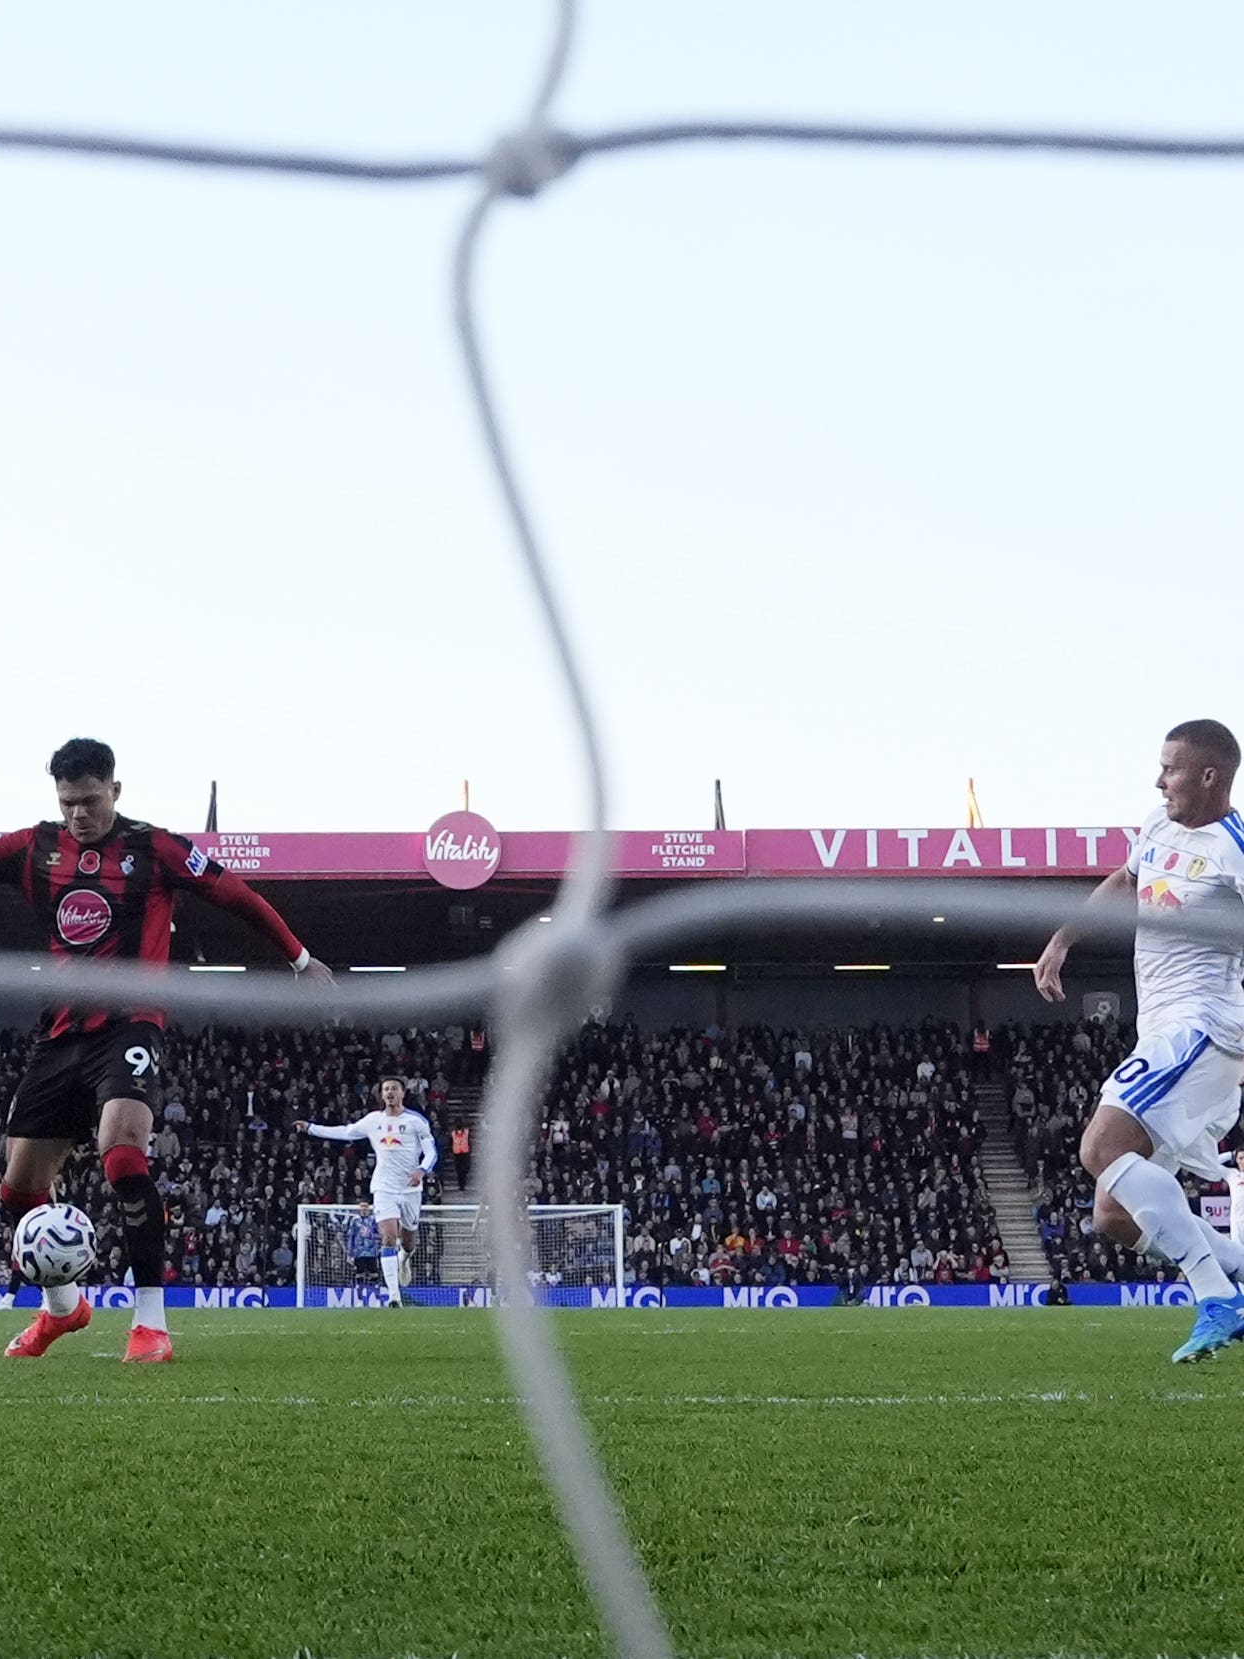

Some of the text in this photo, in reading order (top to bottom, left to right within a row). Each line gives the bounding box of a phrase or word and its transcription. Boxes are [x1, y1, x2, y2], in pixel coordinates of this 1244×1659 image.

[219, 835, 259, 845] STEVE
[664, 833, 703, 843] STEVE
[207, 847, 271, 857] FLETCHER
[425, 829, 499, 870] Vitality
[651, 845, 715, 855] FLETCHER
[217, 859, 261, 869] STAND
[662, 857, 706, 867] STAND
[124, 1046, 151, 1076] 9
[194, 1287, 269, 1308] MrQ
[723, 1286, 799, 1308] MrQ
[1120, 1284, 1195, 1306] MrQ
